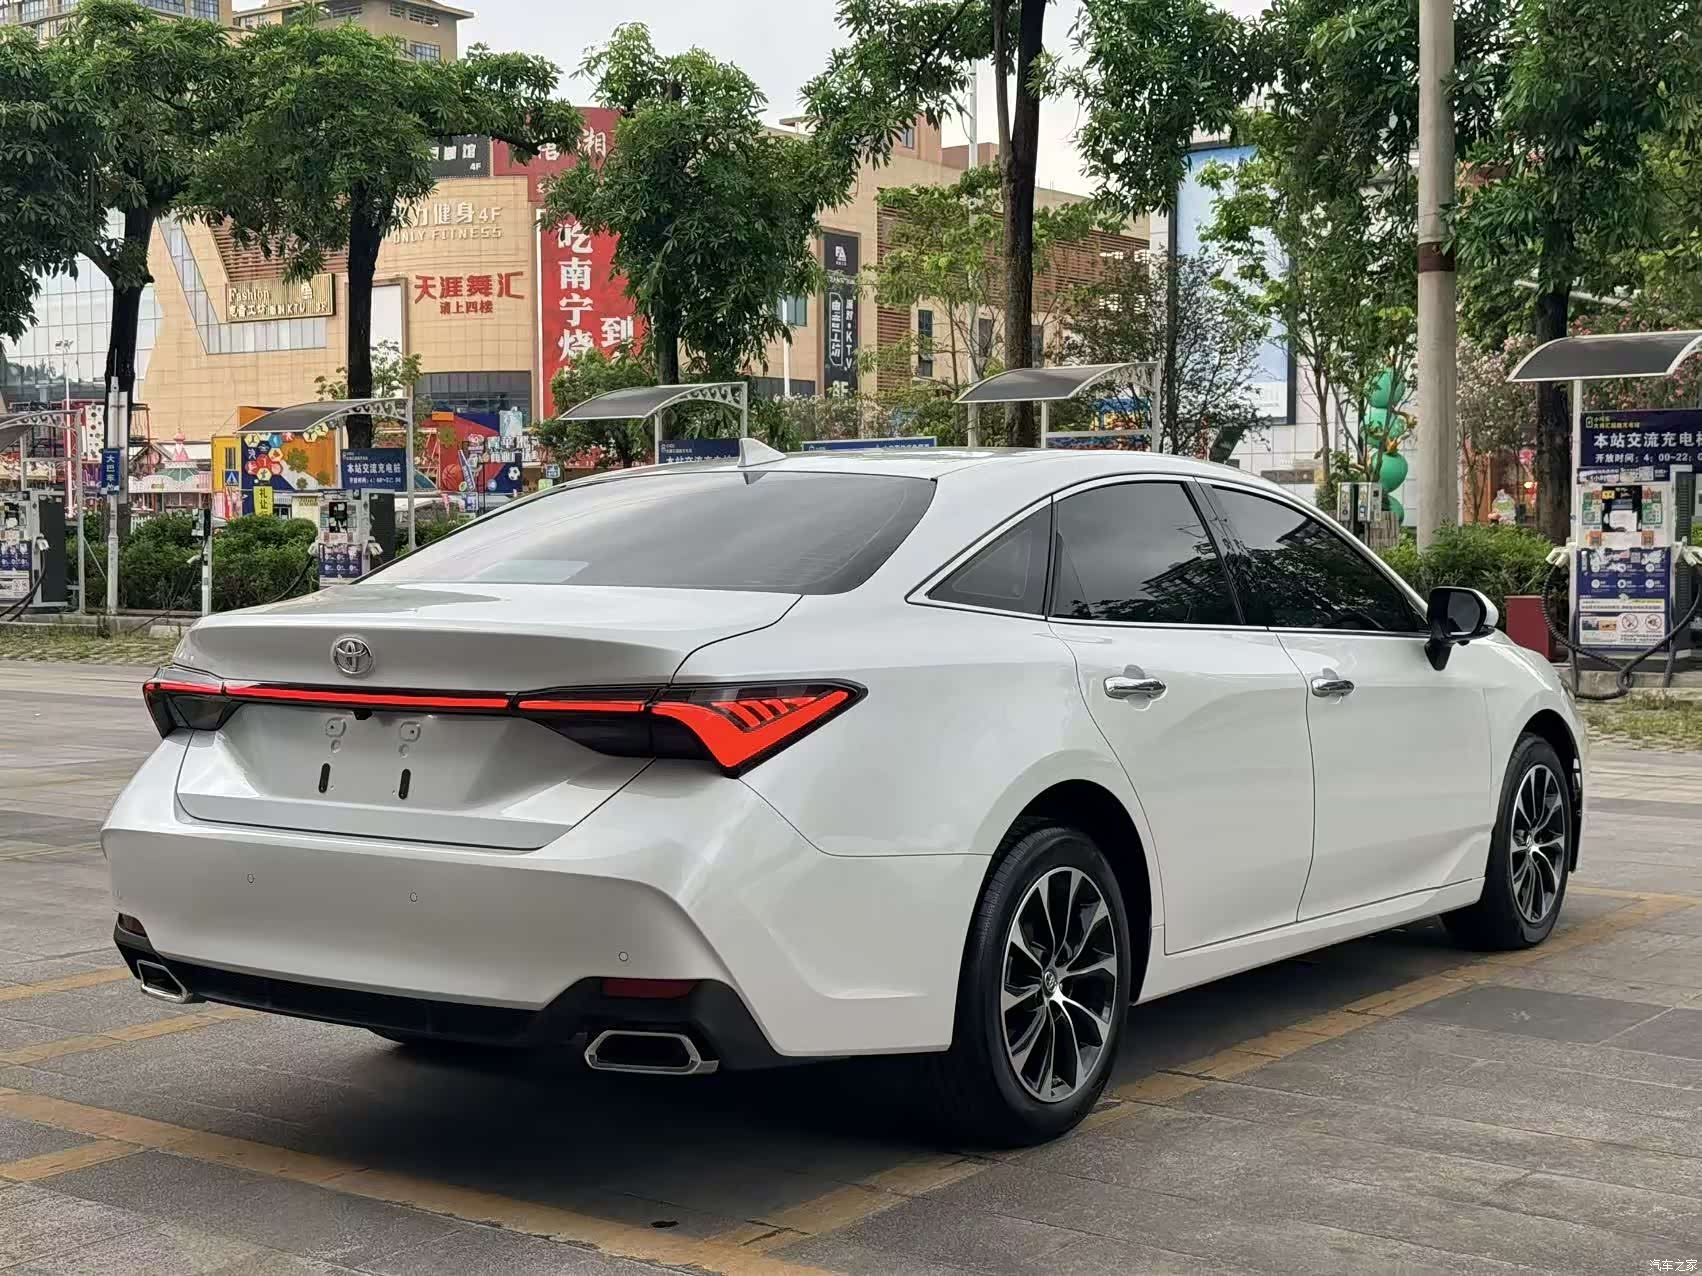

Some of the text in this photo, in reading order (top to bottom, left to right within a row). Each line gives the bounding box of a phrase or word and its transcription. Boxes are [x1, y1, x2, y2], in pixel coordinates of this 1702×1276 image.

[470, 163, 481, 171] 4F
[479, 207, 502, 222] 4F
[393, 227, 502, 243] ONLY FITNESS
[229, 287, 270, 302] Fashion
[414, 271, 525, 304] 天涯舞汇
[558, 221, 594, 376] 吃南宁烧
[440, 300, 493, 315] 请上四楼
